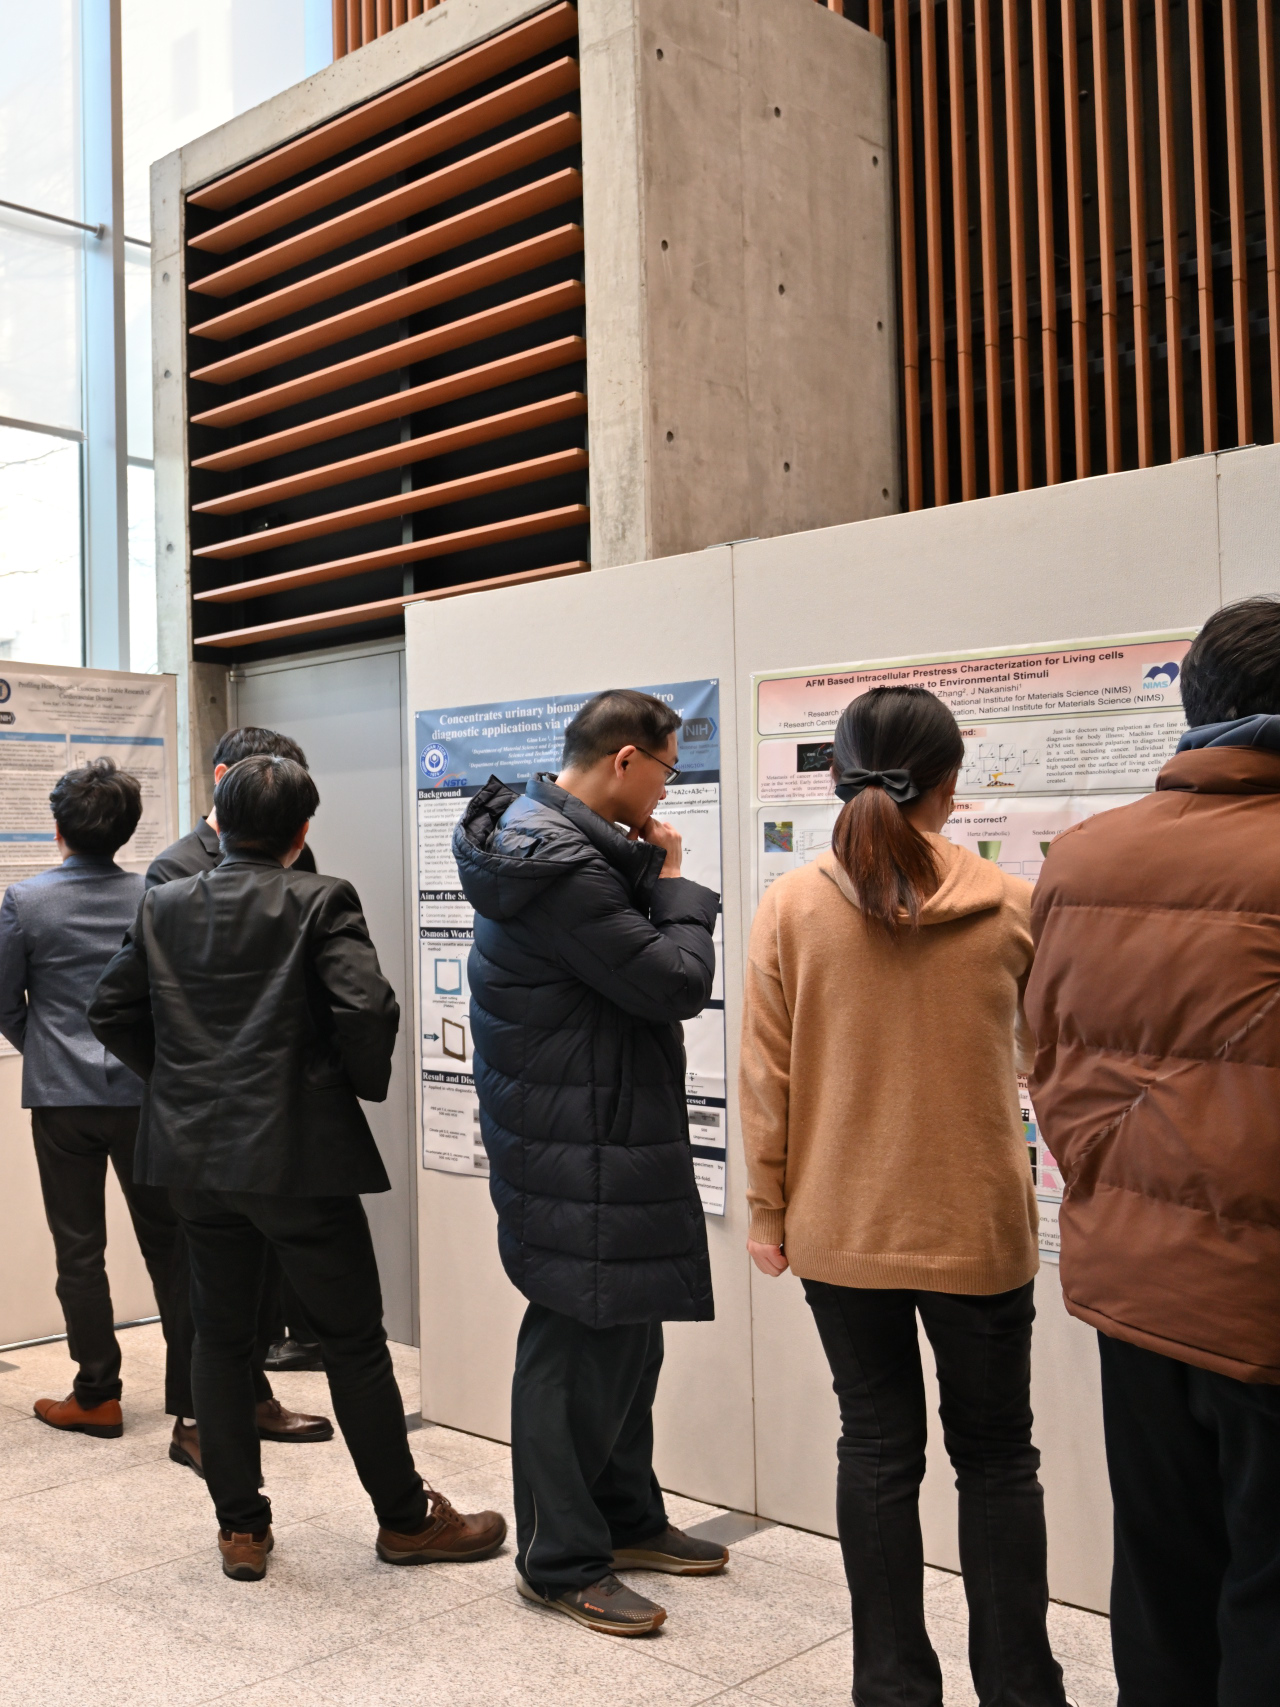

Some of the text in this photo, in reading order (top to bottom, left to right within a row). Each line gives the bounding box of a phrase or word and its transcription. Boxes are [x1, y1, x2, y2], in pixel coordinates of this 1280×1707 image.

[806, 679, 825, 687] AFM
[828, 676, 854, 685] Based
[857, 671, 911, 682] Intracellular
[914, 668, 957, 676] Prestress
[961, 659, 1042, 672] Characterization
[1063, 655, 1096, 663] Living
[1098, 652, 1124, 660] cells
[940, 674, 1010, 687] Environmental
[1014, 670, 1049, 680] Stimuli
[951, 697, 981, 706] National
[984, 694, 1013, 702] Institute
[1028, 691, 1064, 699] Materials
[1101, 685, 1131, 695] (NIMS)
[979, 705, 1010, 714] National
[1013, 703, 1043, 711] Institute
[1058, 700, 1095, 708] Materials
[1134, 694, 1165, 704] (NIMS)
[440, 710, 502, 725] Concentrates
[505, 705, 543, 718] urinary
[808, 709, 839, 717] Research
[784, 720, 814, 728] Research
[432, 727, 479, 741] diagnostic
[482, 722, 542, 737] applications
[545, 721, 560, 729] via
[686, 724, 708, 736] NIH
[443, 778, 467, 787] NSTC
[419, 789, 461, 799] Background
[420, 892, 435, 900] Aim
[436, 892, 444, 900] of
[421, 929, 448, 937] Osmosis
[423, 1072, 444, 1081] Result
